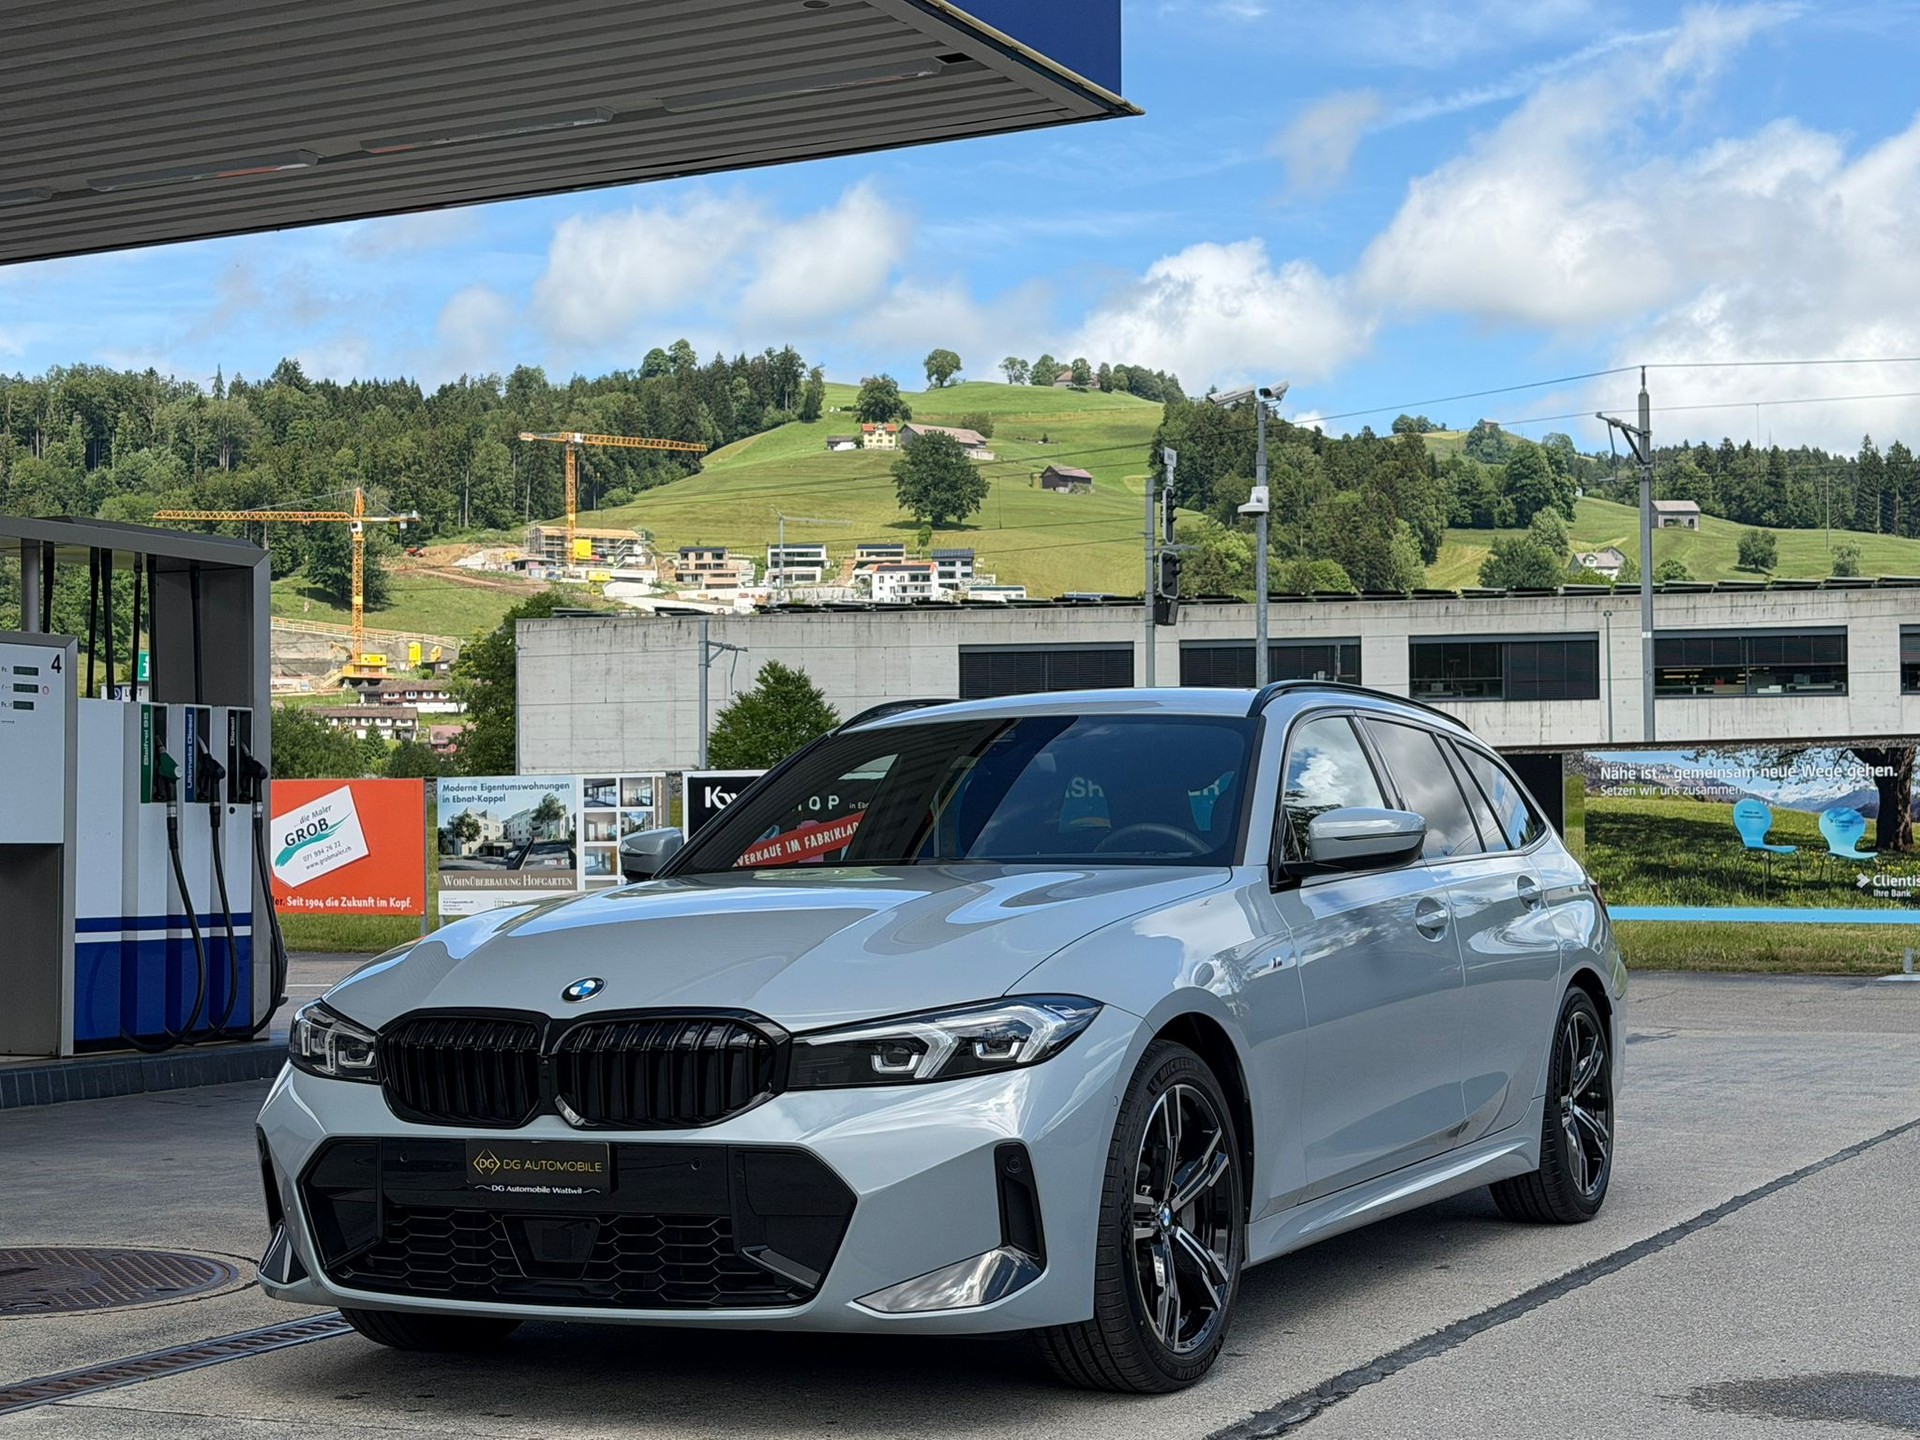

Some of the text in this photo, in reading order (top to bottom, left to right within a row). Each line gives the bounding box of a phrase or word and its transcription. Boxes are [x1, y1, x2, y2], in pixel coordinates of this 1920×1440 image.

[51, 653, 62, 674] 4
[1600, 763, 1898, 782] Nähe ist... gemeinsam neue Wege gehen.
[442, 782, 570, 793] Moderne Eigentumswohnungen
[1600, 785, 1745, 796] Setzen wir uns zusammen.
[442, 794, 506, 804] in Ebnat-Kappel
[311, 805, 332, 819] Maler
[284, 818, 329, 847] GROB
[785, 838, 801, 853] IM
[303, 853, 313, 862] 071
[1873, 874, 1920, 887] Clientis
[1873, 889, 1911, 898] Ihre Bank
[287, 896, 303, 906] Seit
[305, 898, 324, 909] 1904
[325, 897, 339, 907] die
[340, 897, 375, 907] Zukunft
[376, 897, 387, 908] im
[389, 897, 412, 911] Kopf.
[479, 1159, 603, 1172] DG DG AUTOMOBILE
[491, 1184, 583, 1195] DG Automobile Wattwil
